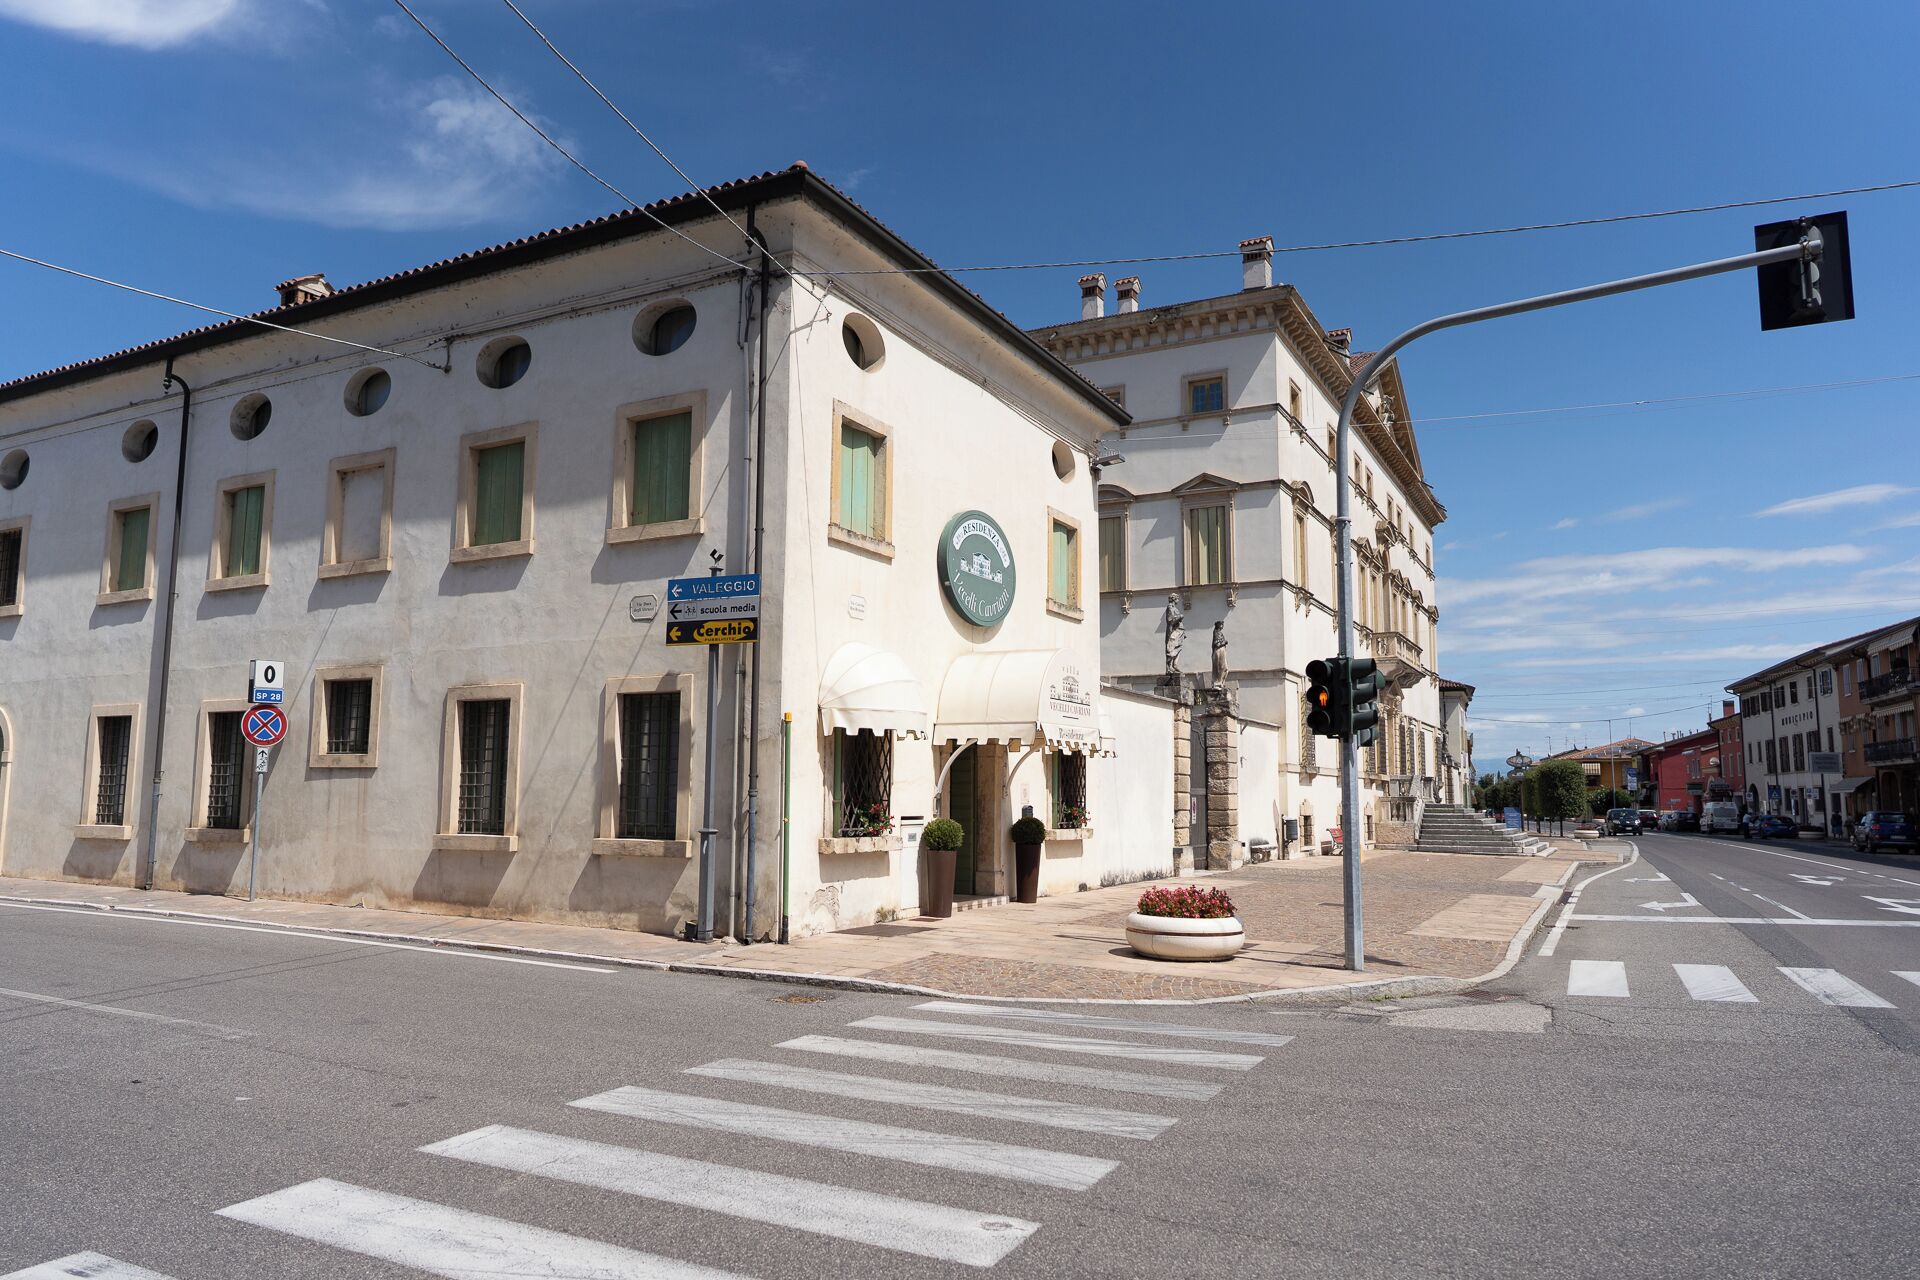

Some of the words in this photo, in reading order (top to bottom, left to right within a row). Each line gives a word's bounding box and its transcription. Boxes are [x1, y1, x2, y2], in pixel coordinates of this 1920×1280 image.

[962, 522, 1000, 548] RESIDENZA
[692, 580, 756, 594] VALEGGIO
[700, 605, 727, 615] scuola
[730, 603, 756, 613] media
[696, 621, 752, 638] Cerchio
[264, 665, 276, 684] 0
[256, 692, 268, 700] SP
[270, 693, 281, 701] 28
